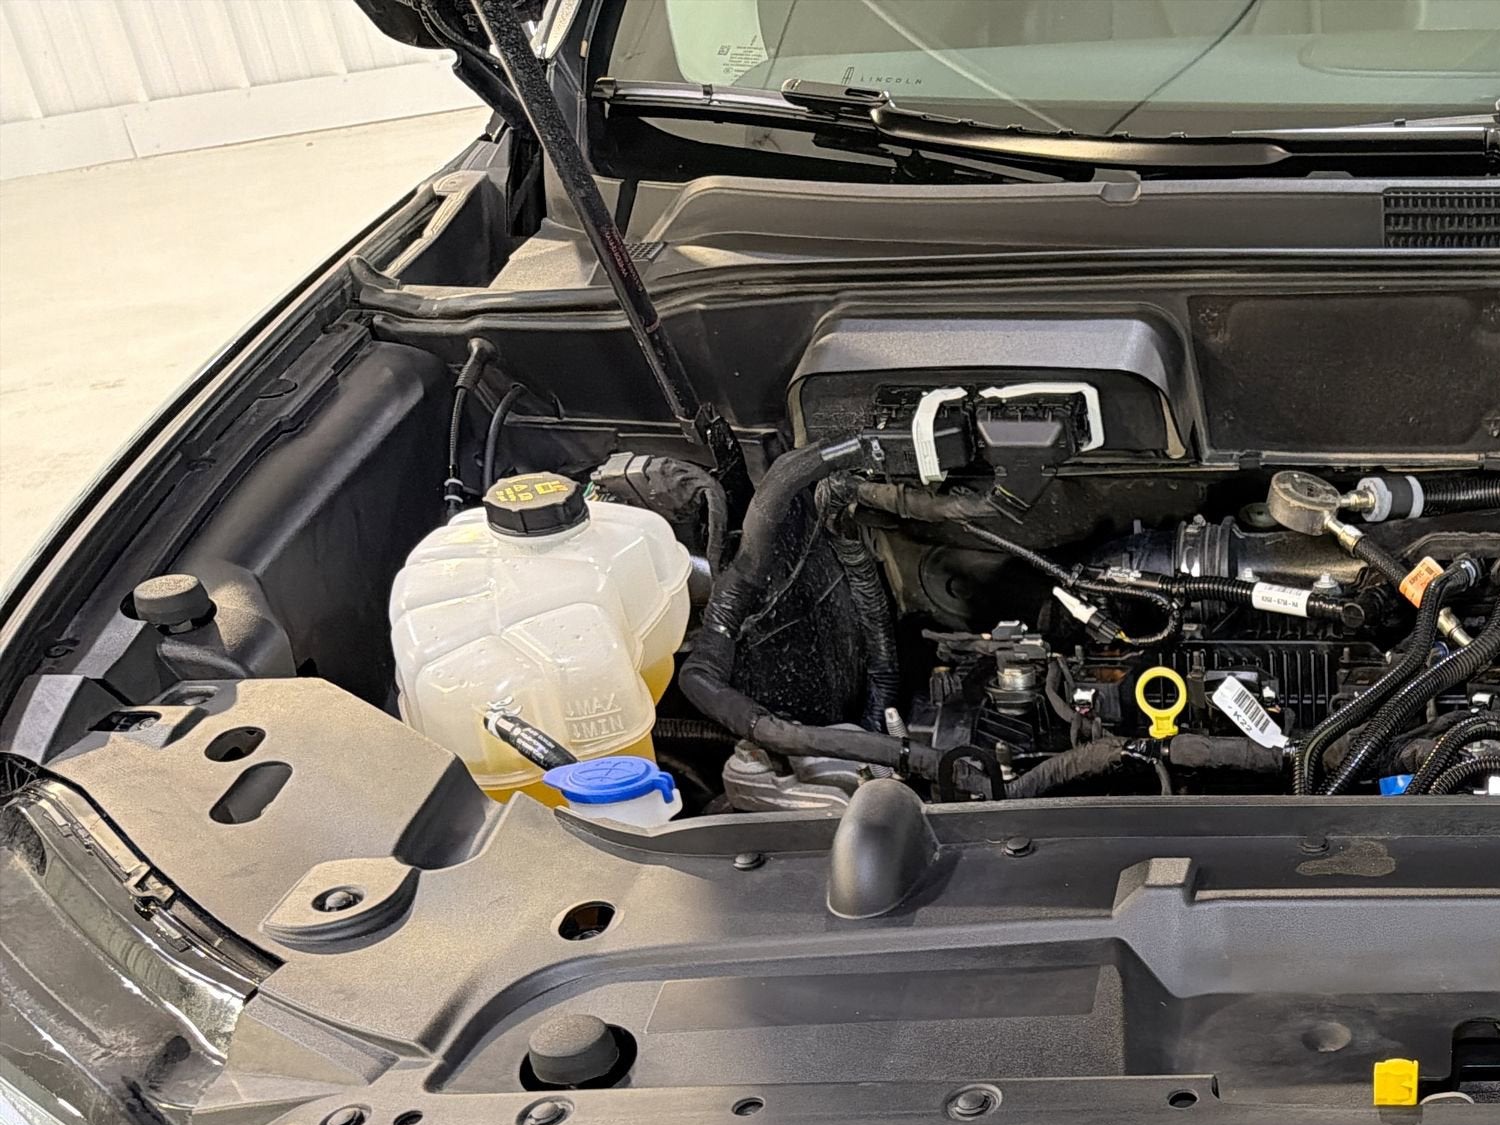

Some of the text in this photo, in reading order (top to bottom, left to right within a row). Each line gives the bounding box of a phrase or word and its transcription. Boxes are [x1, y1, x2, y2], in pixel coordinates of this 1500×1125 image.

[860, 74, 923, 85] LINCOLN
[575, 692, 618, 716] MAX
[581, 715, 625, 739] MIN
